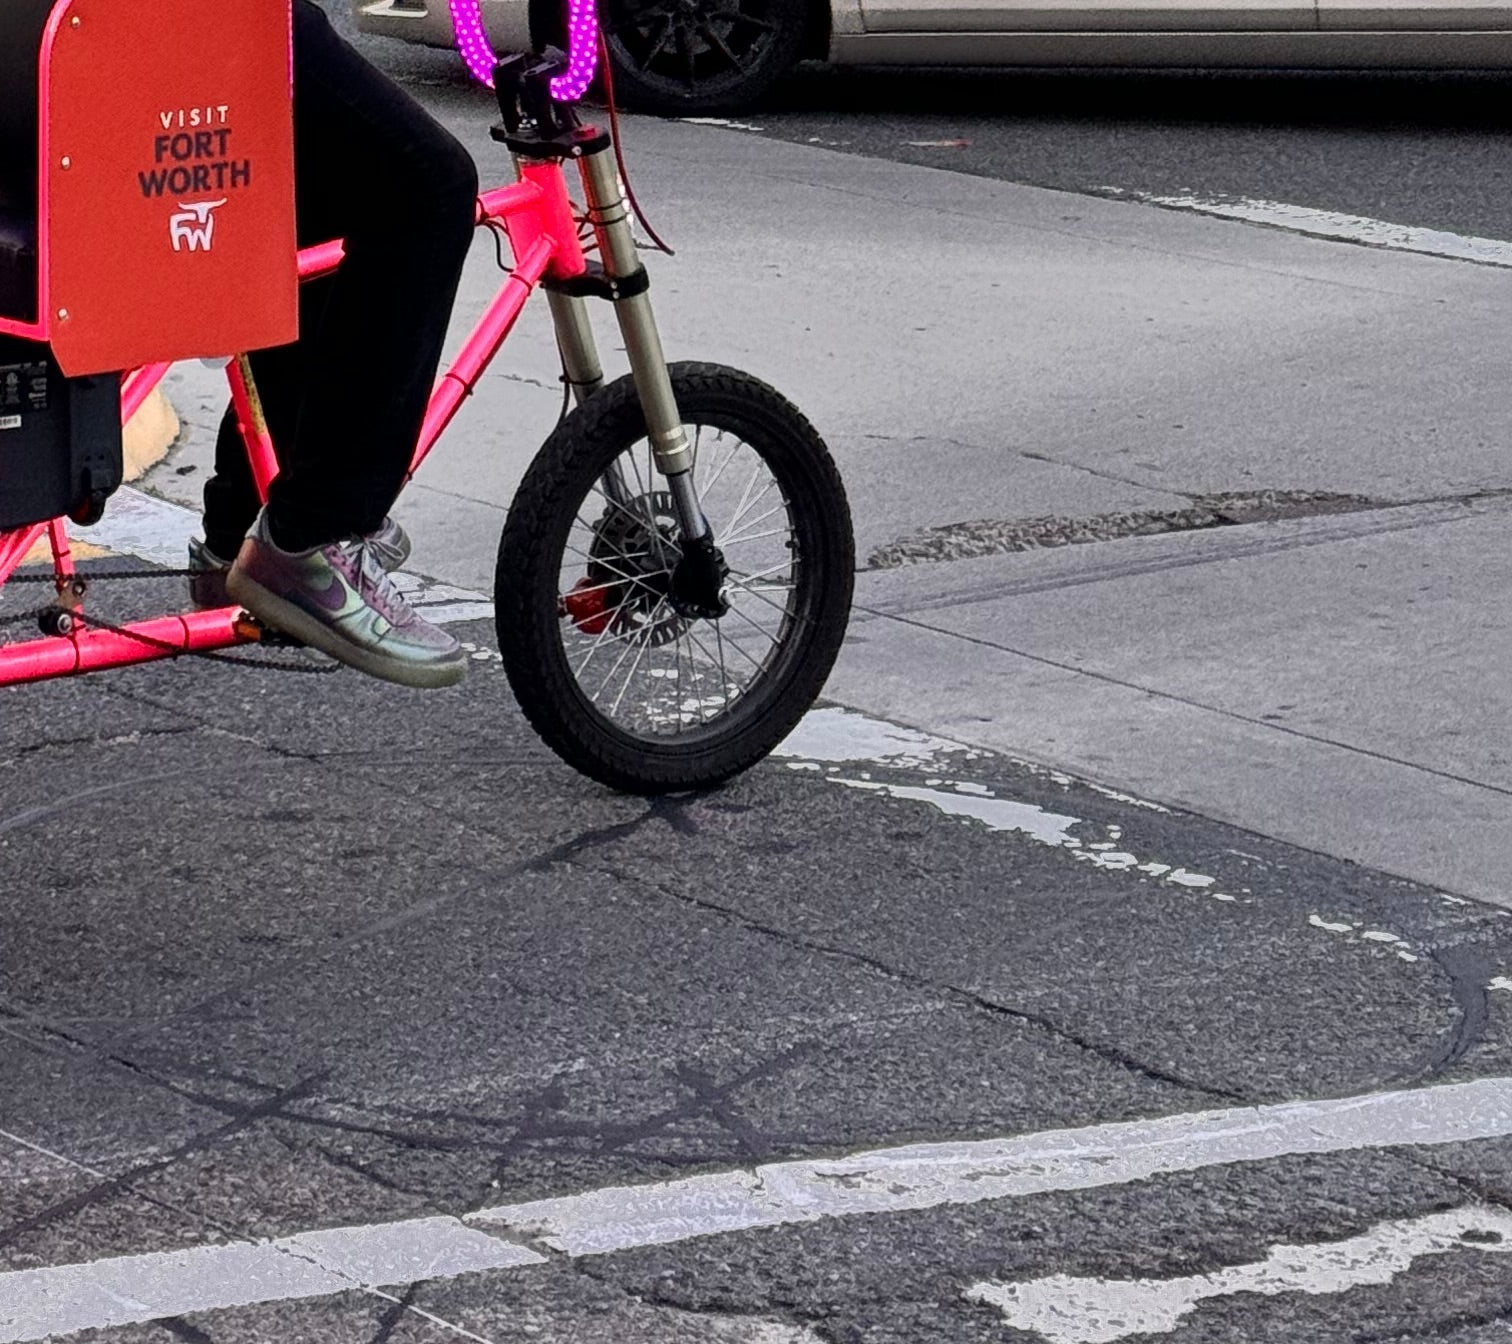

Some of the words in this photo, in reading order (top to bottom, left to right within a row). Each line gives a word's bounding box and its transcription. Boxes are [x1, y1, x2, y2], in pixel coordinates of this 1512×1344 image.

[160, 105, 228, 129] VISIT
[154, 128, 232, 163] FORT
[138, 160, 251, 198] WORTH
